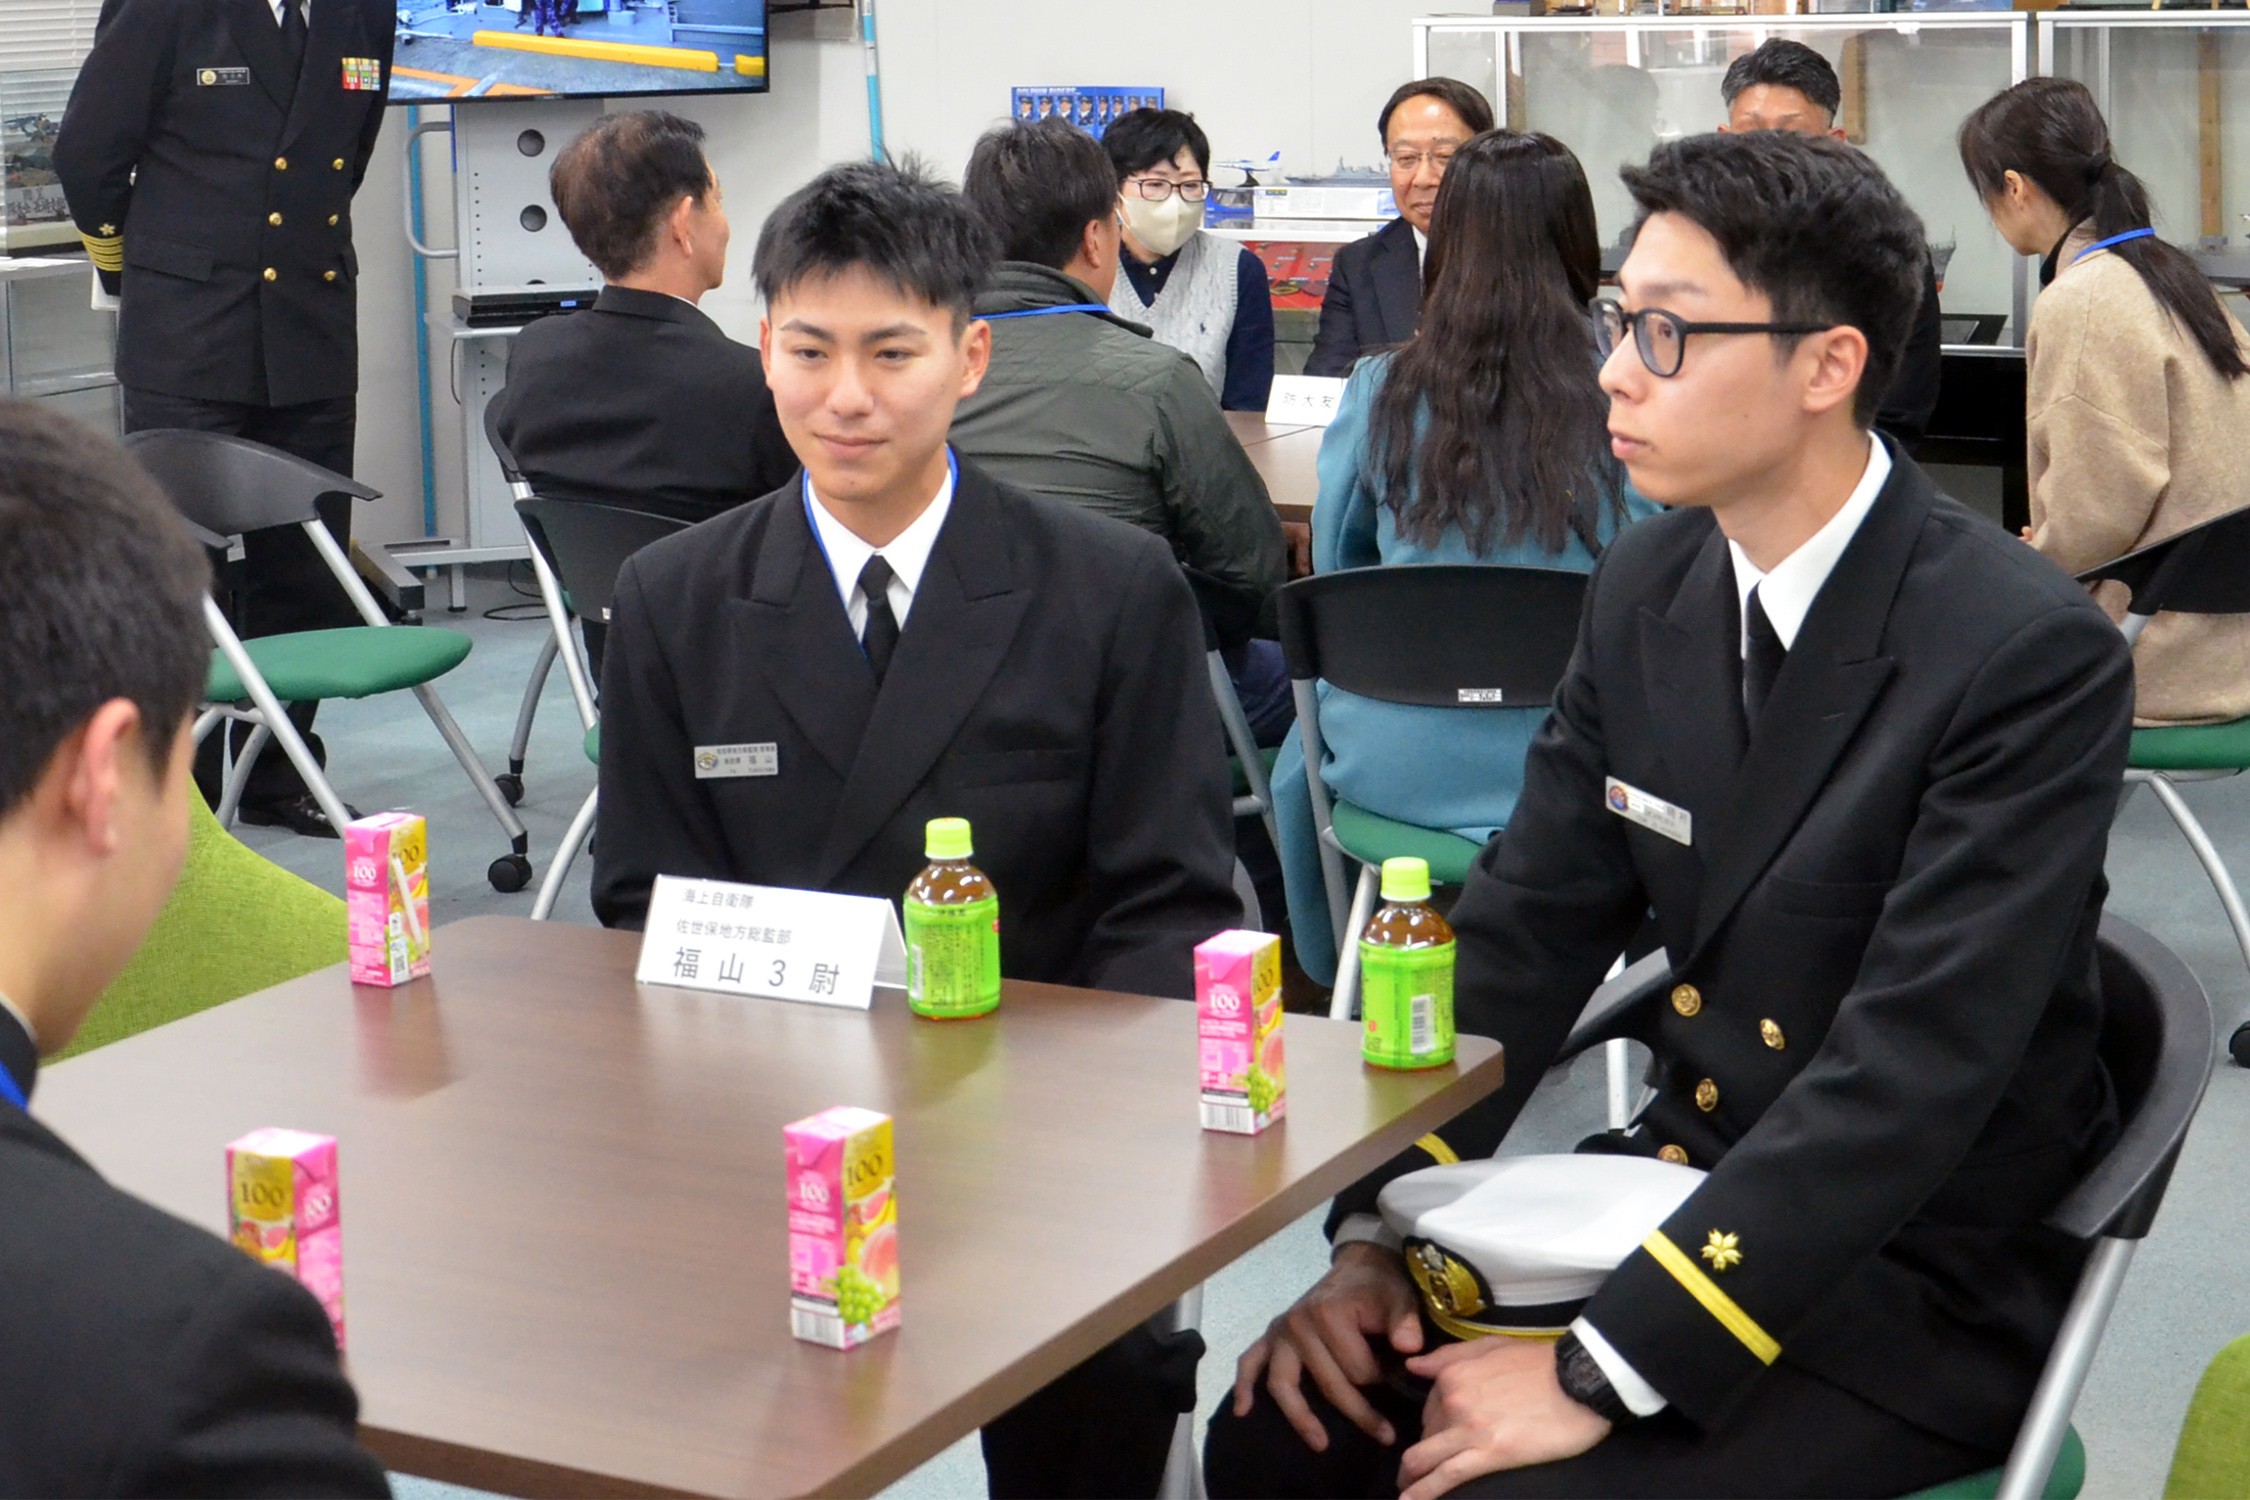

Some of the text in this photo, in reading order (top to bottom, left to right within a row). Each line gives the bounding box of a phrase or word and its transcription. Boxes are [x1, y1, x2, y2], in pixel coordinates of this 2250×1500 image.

[353, 865, 377, 880] 100
[683, 888, 754, 909] 海上自衛隊
[677, 919, 792, 945] 佐世保地方総監部
[1209, 993, 1240, 1011] 100
[847, 1153, 882, 1186] 100
[242, 1181, 285, 1207] 100
[799, 1181, 830, 1203] 100
